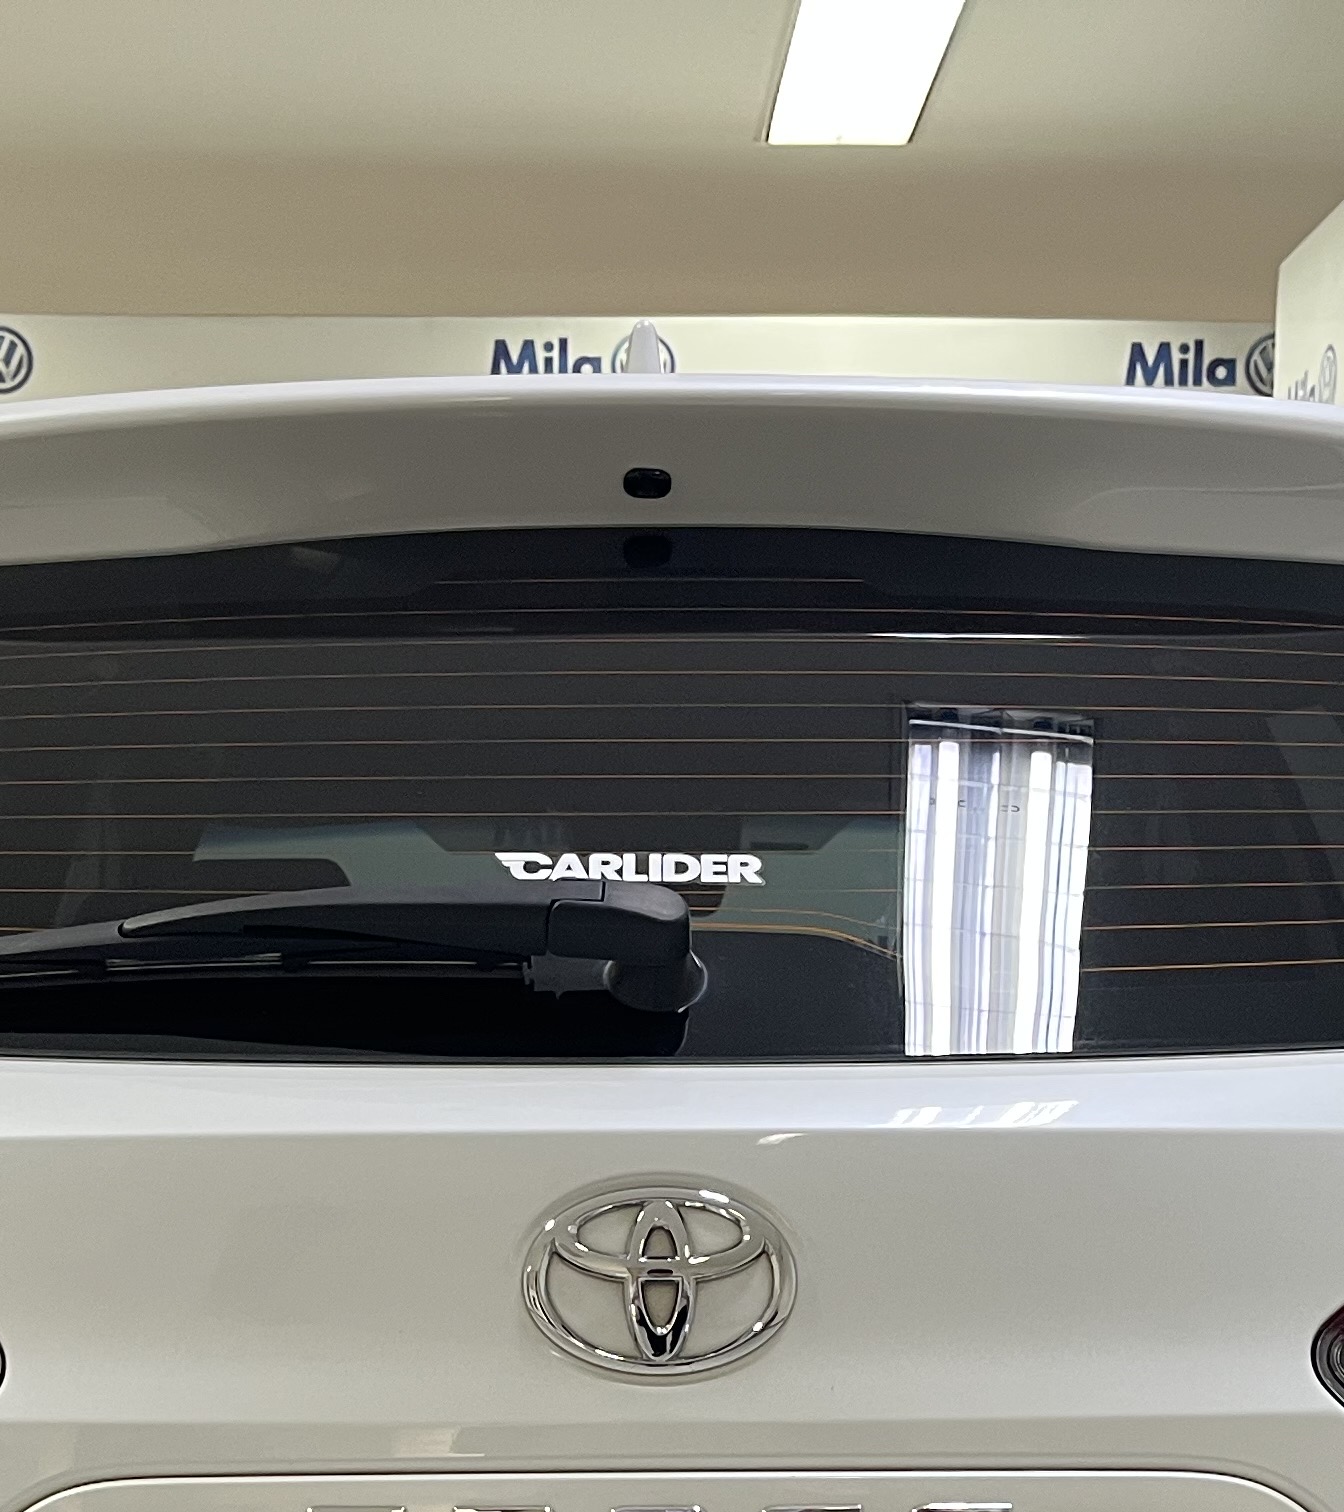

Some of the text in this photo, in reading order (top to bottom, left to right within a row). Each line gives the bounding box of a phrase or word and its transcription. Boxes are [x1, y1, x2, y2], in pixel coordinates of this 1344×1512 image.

[490, 337, 602, 376] Mila
[1125, 338, 1238, 387] Mila
[494, 852, 764, 885] CARLIDER
